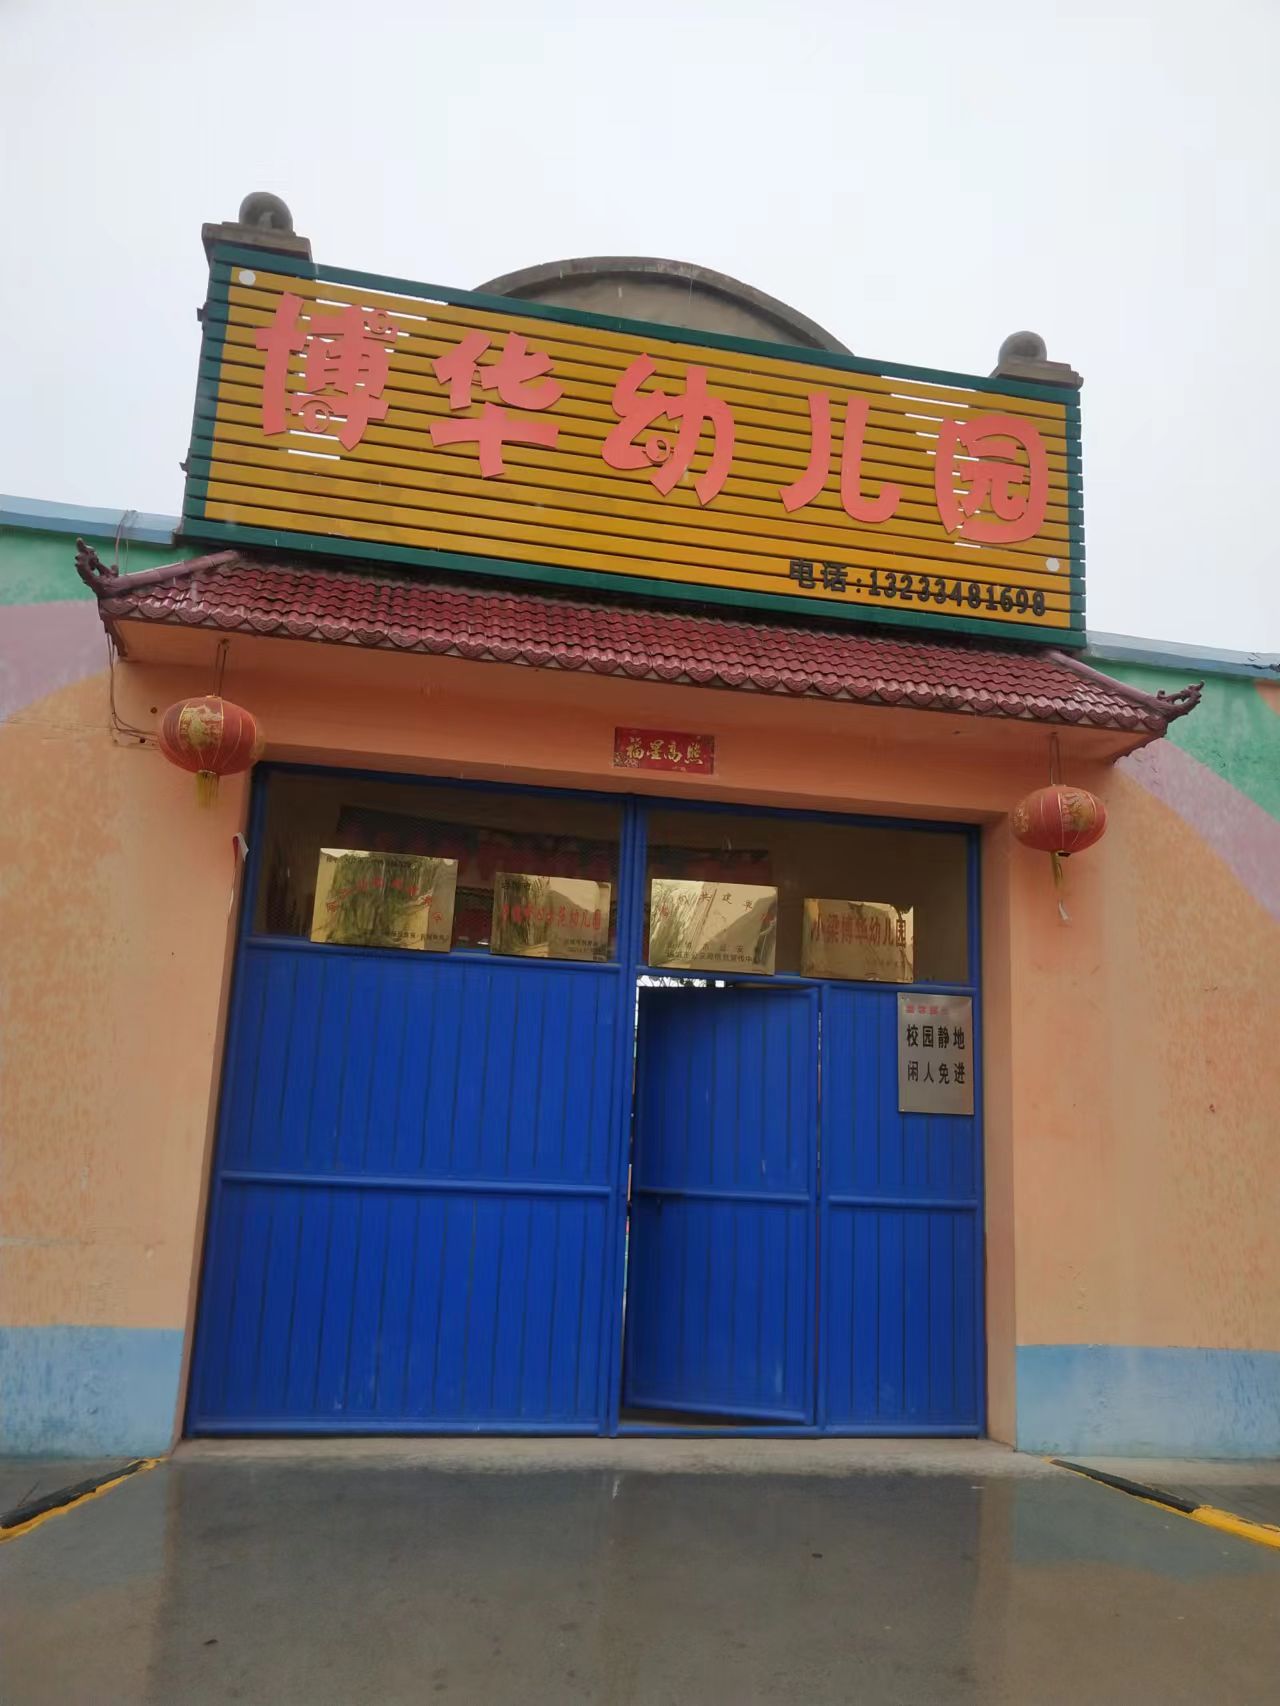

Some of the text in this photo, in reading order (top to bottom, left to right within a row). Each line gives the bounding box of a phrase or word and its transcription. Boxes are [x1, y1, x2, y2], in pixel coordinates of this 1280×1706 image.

[255, 290, 1049, 544] 博华幼儿园
[625, 737, 704, 765] 福星高照
[906, 1024, 965, 1049] 校园静地
[907, 1060, 966, 1084] 闲人免进
